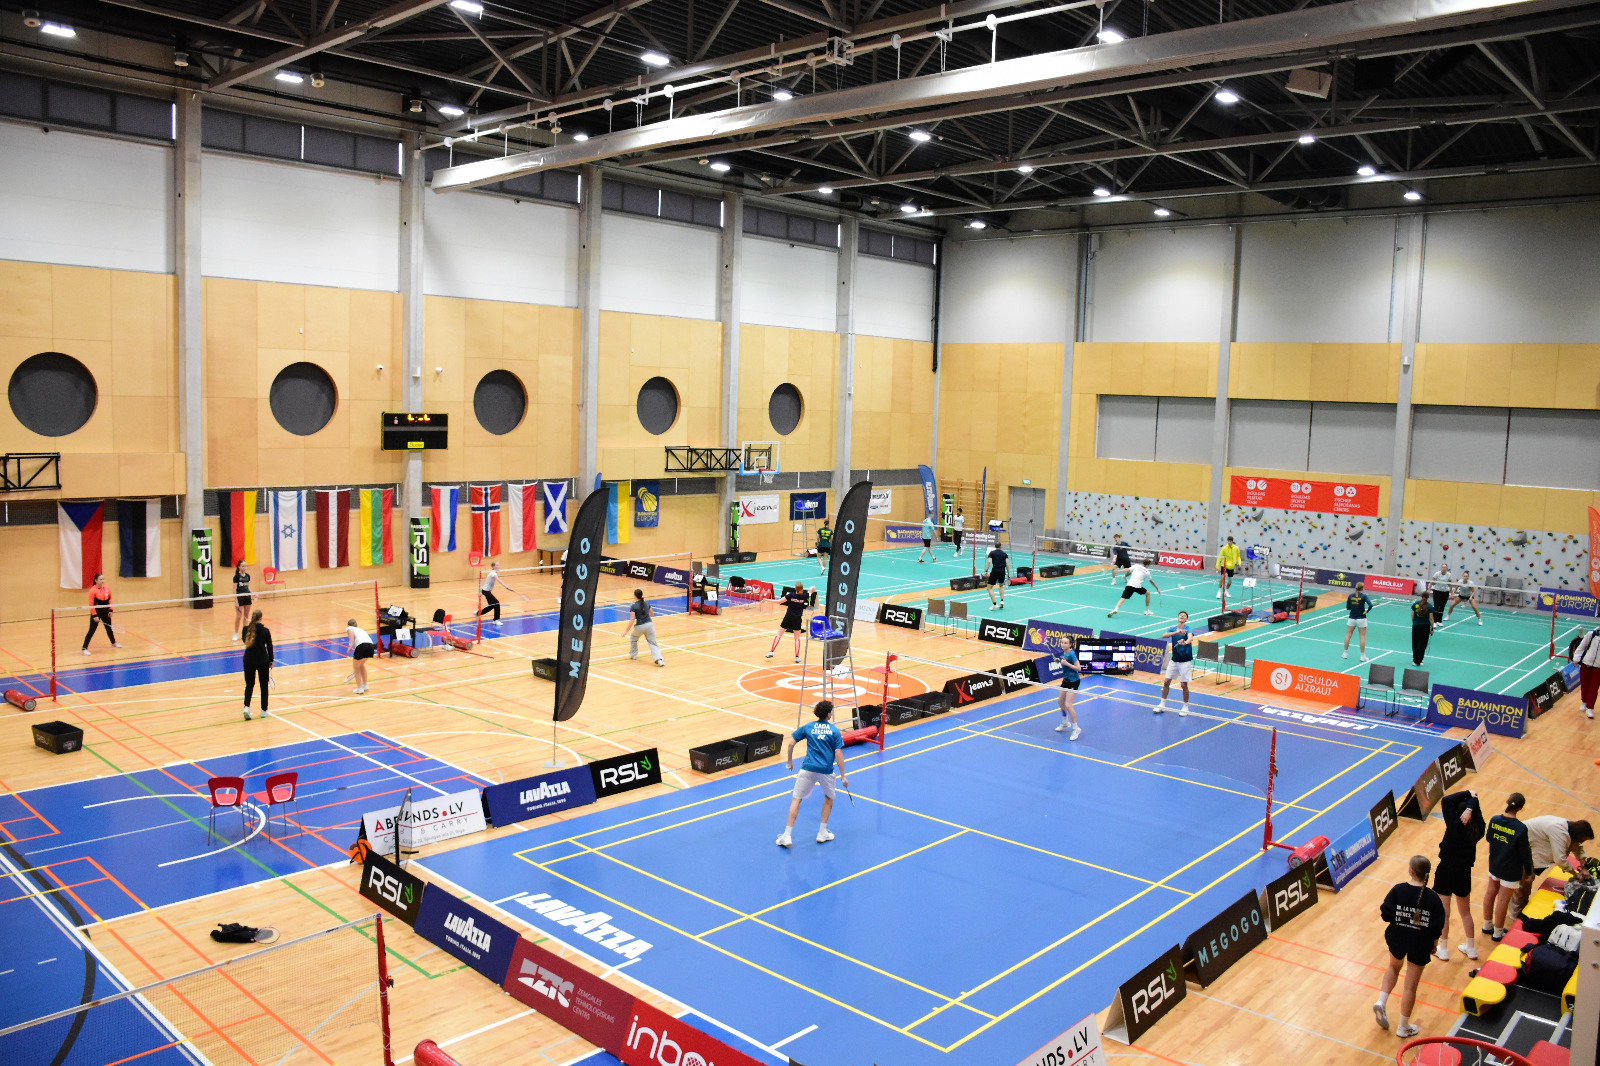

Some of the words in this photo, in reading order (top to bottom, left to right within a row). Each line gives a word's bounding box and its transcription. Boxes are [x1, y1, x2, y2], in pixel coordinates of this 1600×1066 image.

[945, 504, 953, 534] RSL
[414, 532, 427, 575] RSL
[1159, 554, 1201, 567] inbox.lv
[198, 544, 212, 594] RSL
[630, 565, 649, 577] RSL
[835, 520, 855, 634] MEGOGO
[568, 537, 591, 678] MEGOGO
[1556, 594, 1596, 603] BADMINTON
[1556, 600, 1595, 611] EUROPE
[885, 610, 912, 624] RSL
[984, 624, 1015, 642] RSL
[1134, 645, 1164, 655] MINTON
[1006, 668, 1030, 686] RSL
[1275, 672, 1288, 686] S!
[1298, 674, 1339, 688] S!GULDA
[1294, 683, 1331, 696] AIZRAUJ
[1455, 706, 1521, 729] EUROPE
[1458, 697, 1524, 716] BADMINTON
[715, 756, 733, 766] RSL
[754, 747, 770, 756] RSL
[599, 762, 649, 789] RSL
[1443, 756, 1462, 780] RSL
[520, 781, 571, 805] LAVAZZA
[433, 817, 469, 831] CARRY
[1375, 807, 1394, 837] RSL
[368, 865, 407, 911] RSL
[1274, 880, 1309, 916] RSL
[443, 912, 491, 953] LAVAZZA
[514, 893, 653, 959] LAVAZZA
[1198, 908, 1260, 968] MEGOGO
[577, 988, 602, 1006] ZEMGALES
[1131, 972, 1175, 1024] RSL
[572, 1006, 591, 1020] CENTRS
[627, 1015, 714, 1066] inbo
